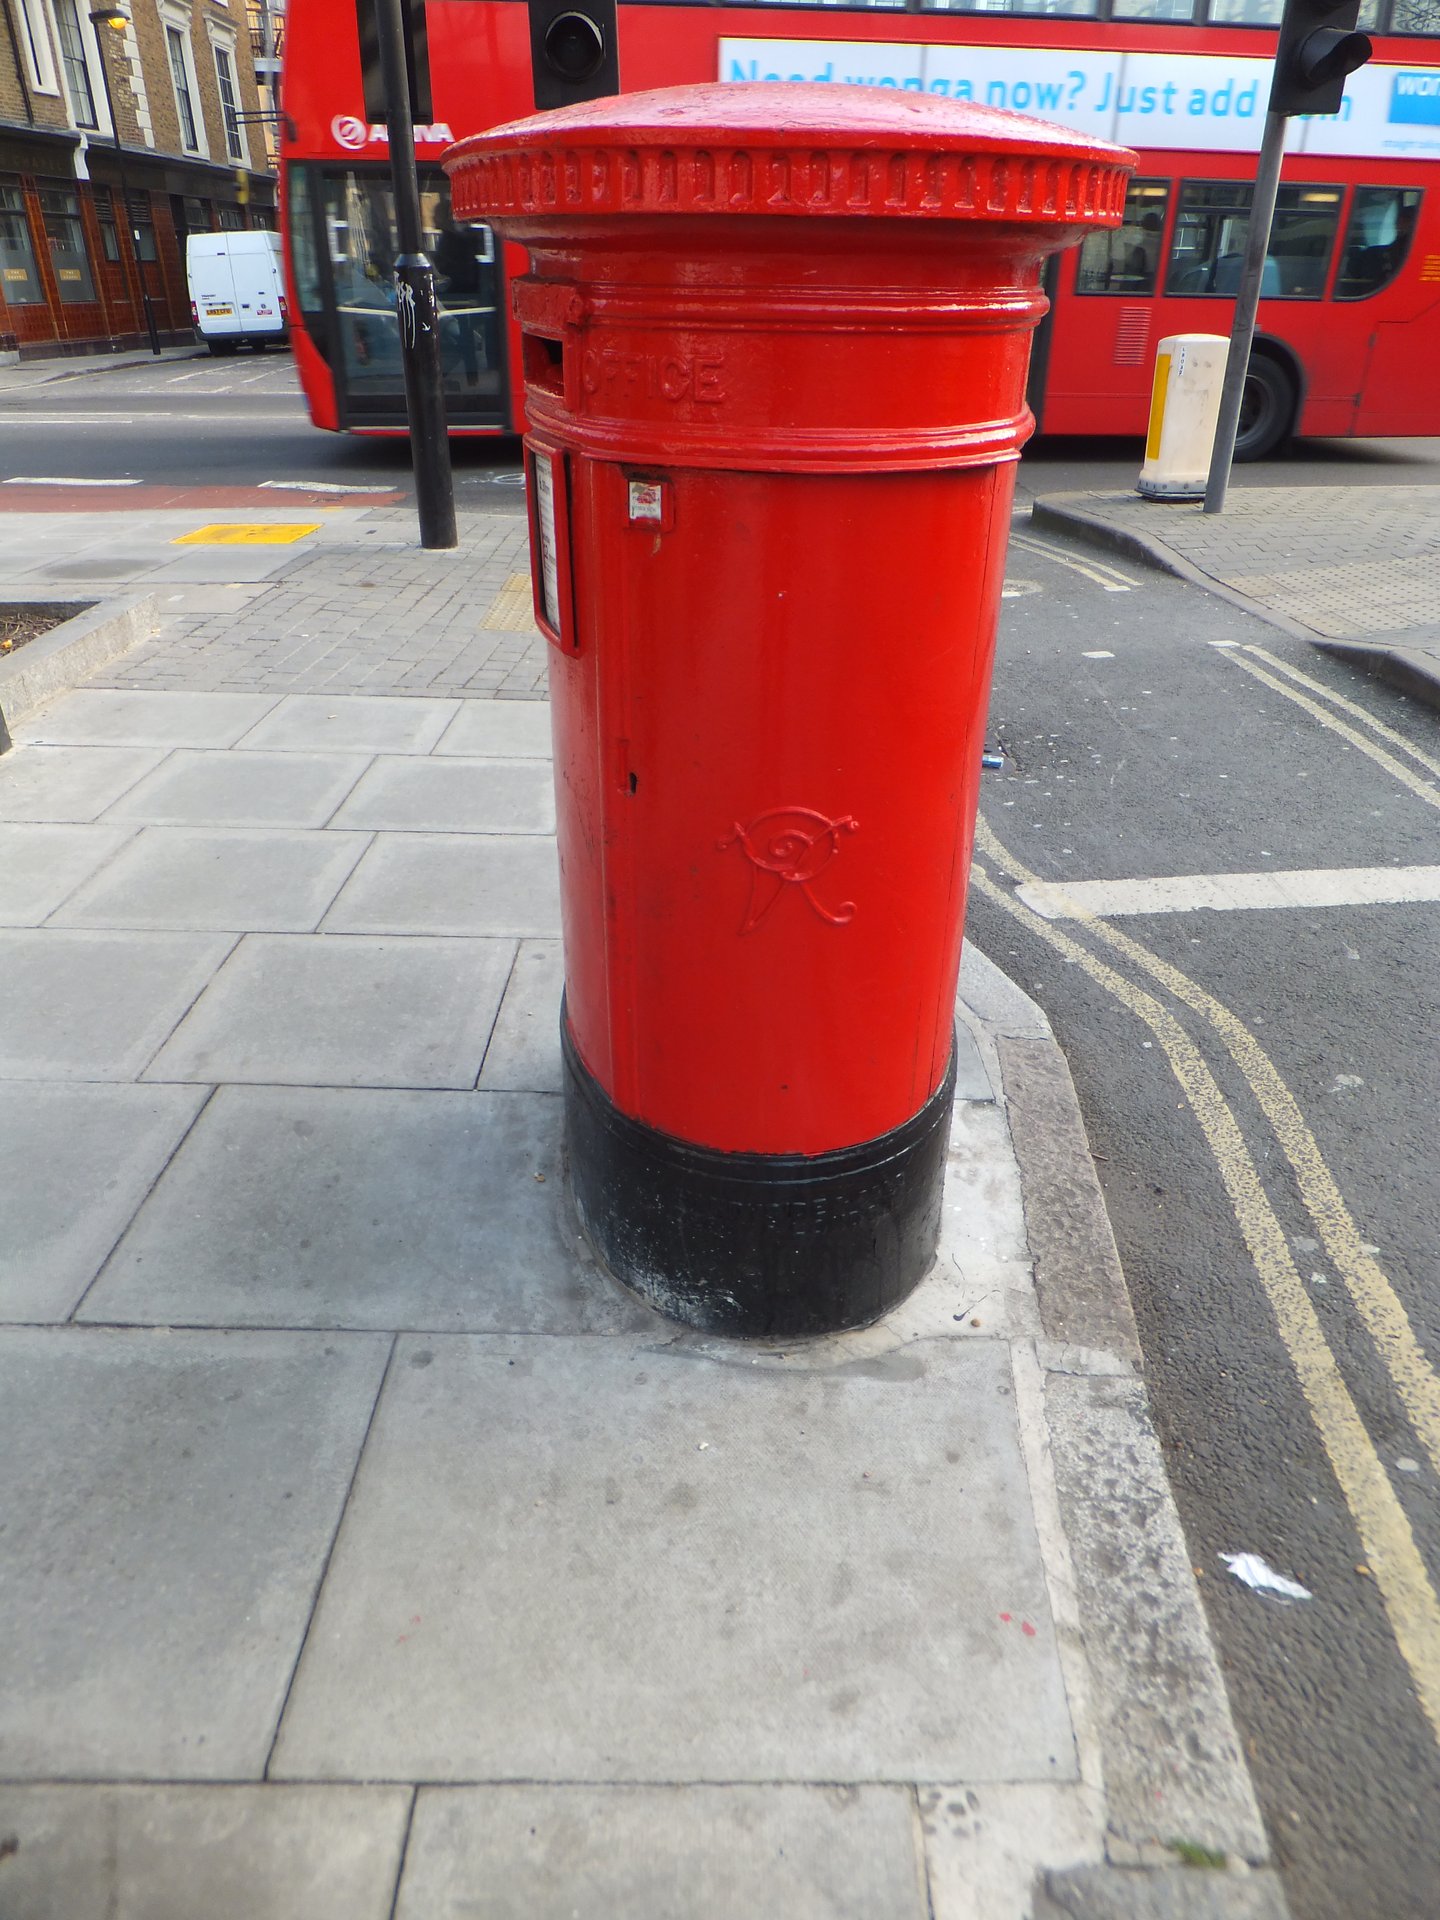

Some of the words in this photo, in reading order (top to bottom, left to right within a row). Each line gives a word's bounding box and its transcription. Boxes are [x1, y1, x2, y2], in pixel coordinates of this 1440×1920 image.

[731, 59, 833, 82] Nd
[986, 70, 1086, 110] now?
[1095, 72, 1178, 115] Just
[1187, 78, 1258, 118] add
[367, 122, 456, 143] AIVA
[582, 349, 727, 403] OFFICE
